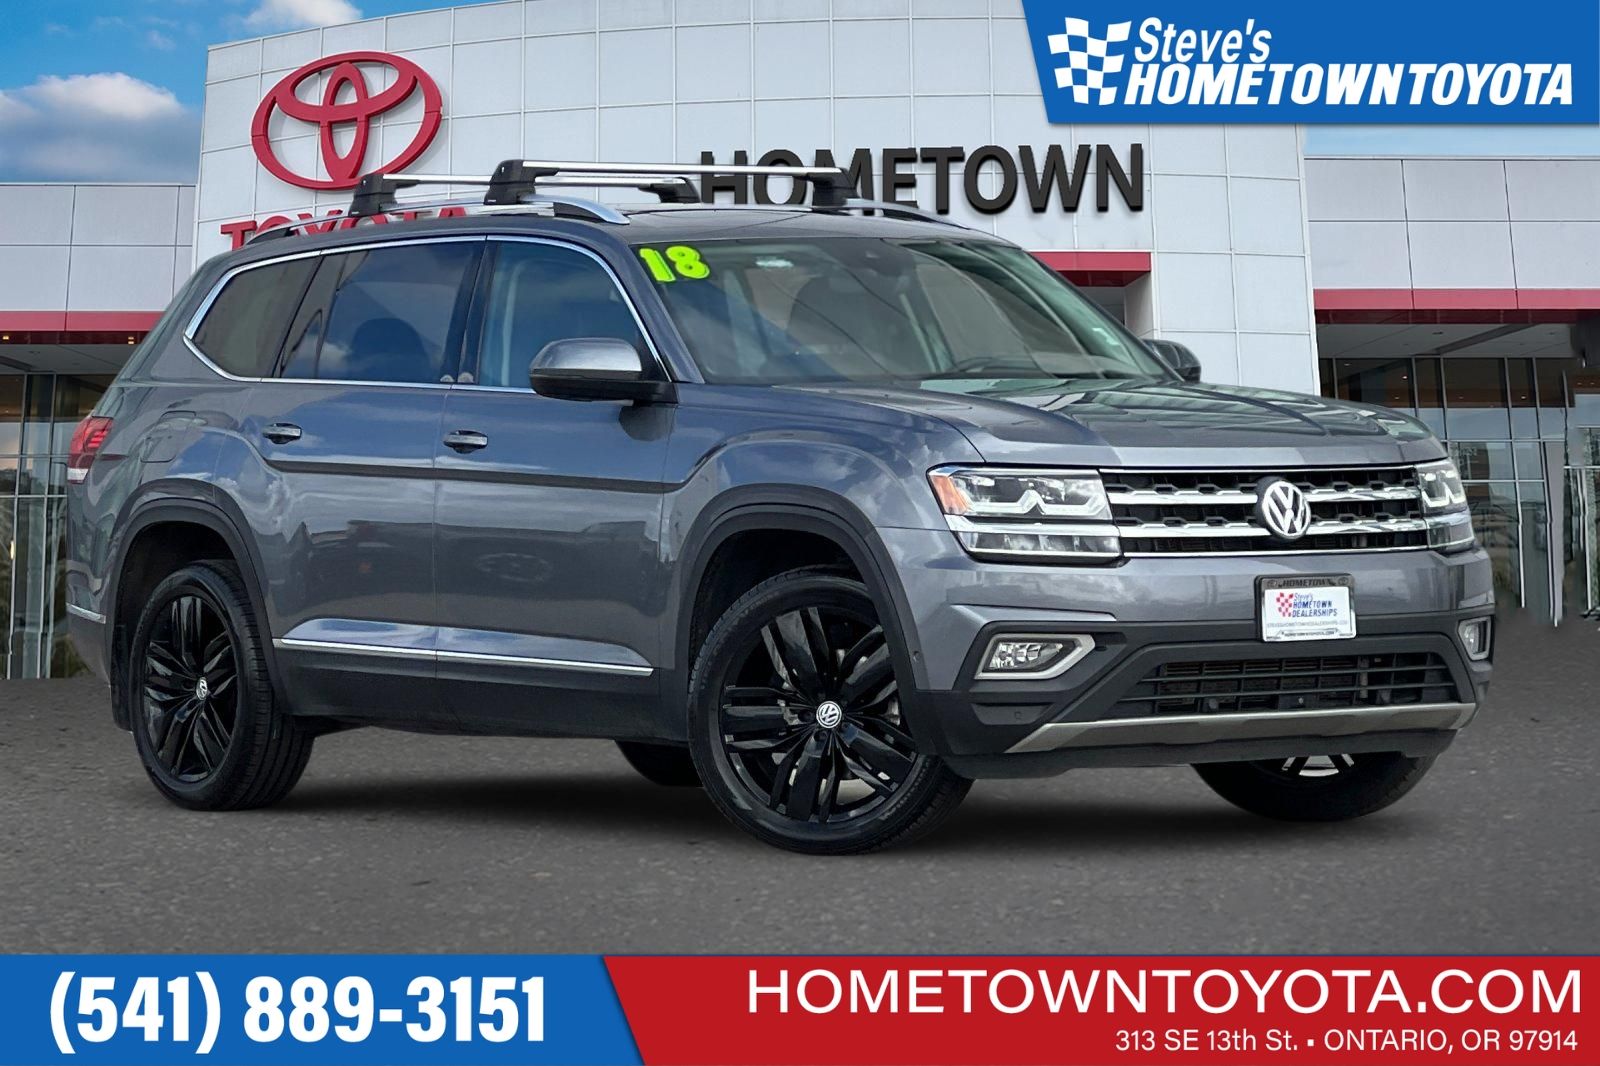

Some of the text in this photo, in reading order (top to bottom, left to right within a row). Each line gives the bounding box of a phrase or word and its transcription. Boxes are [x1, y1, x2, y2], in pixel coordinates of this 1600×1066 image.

[699, 142, 1143, 215] HOMETOWN
[639, 245, 710, 282] 18
[1292, 608, 1338, 618] DEALERSHIPS
[1293, 600, 1332, 609] HOMETOWN
